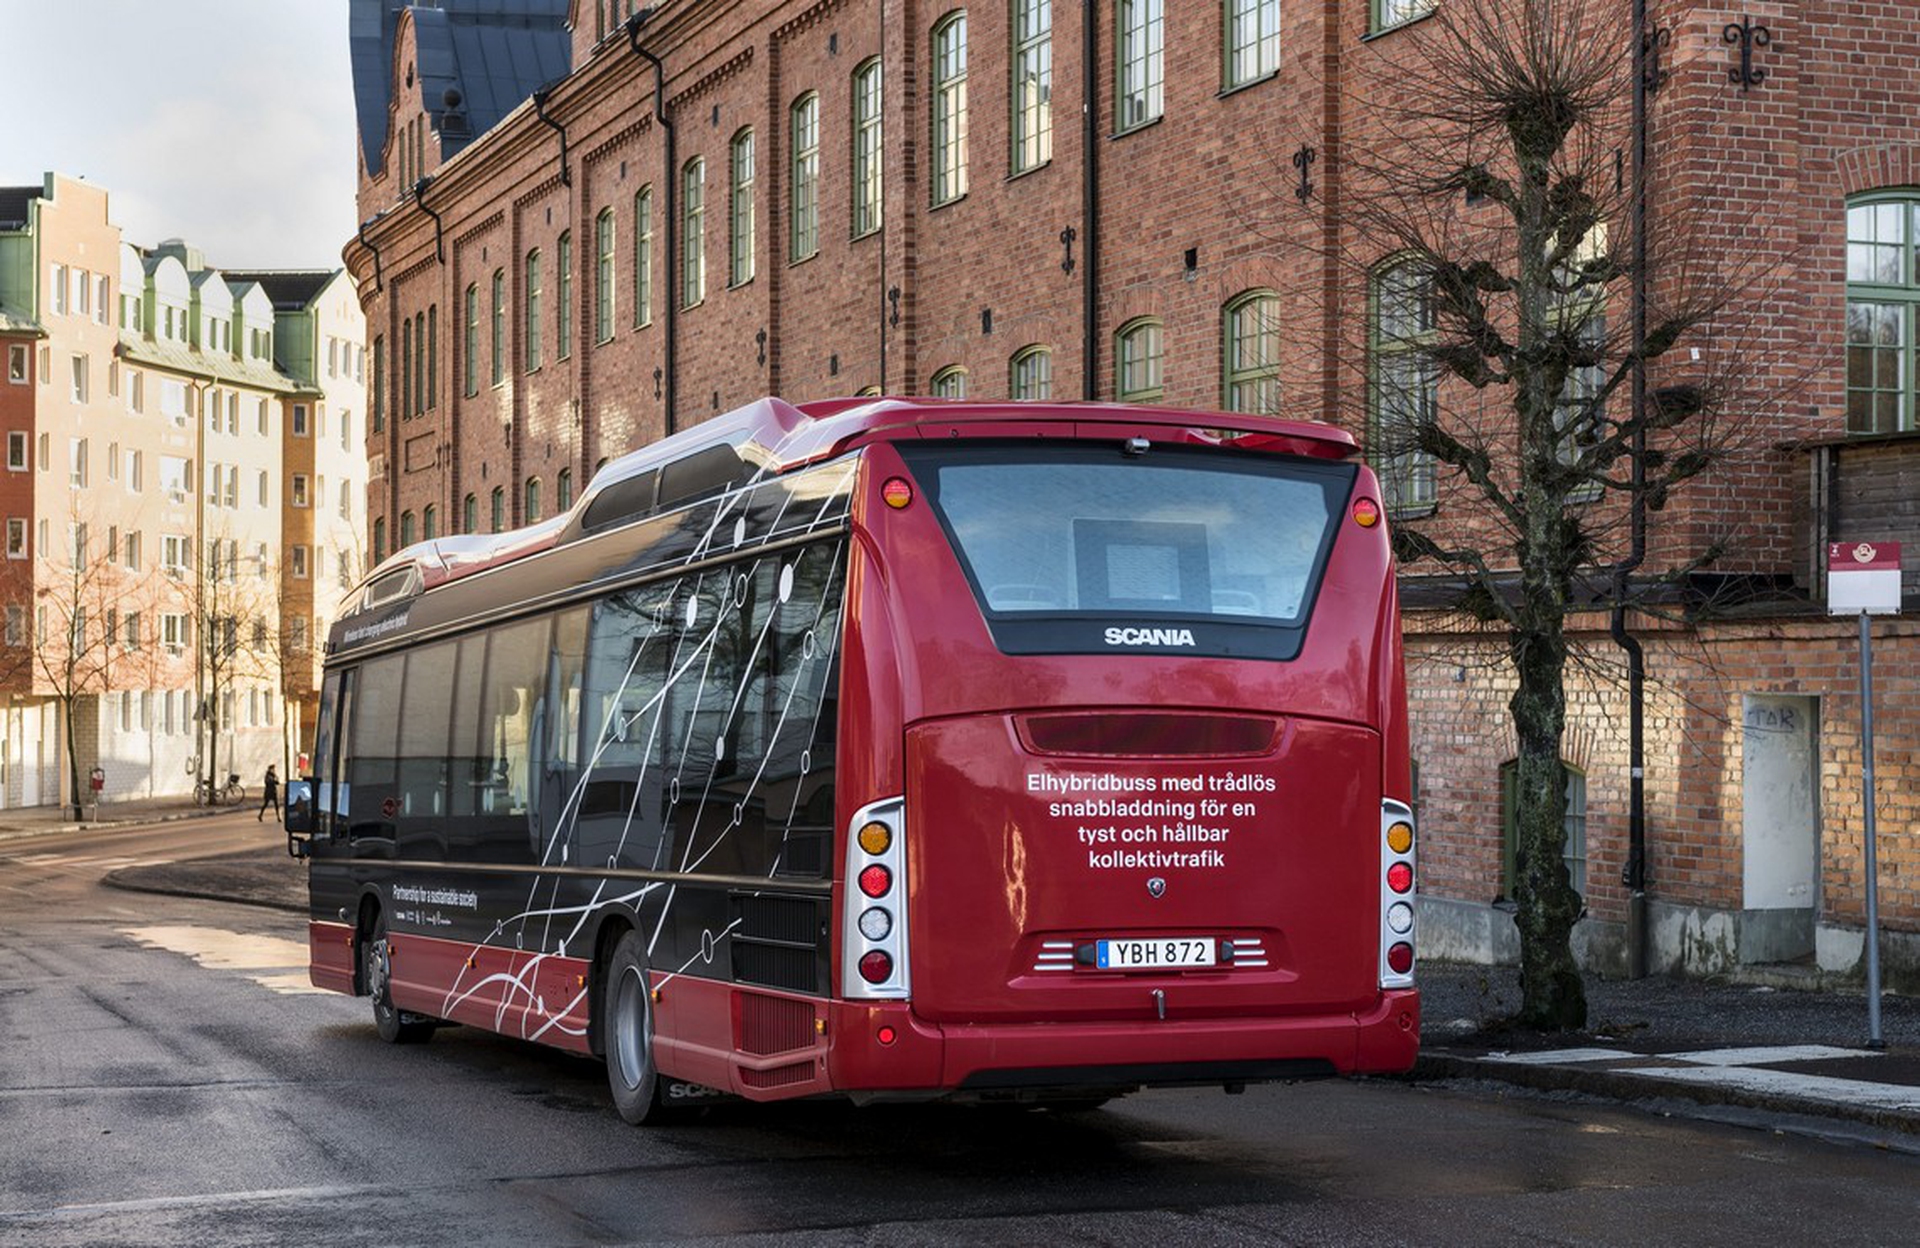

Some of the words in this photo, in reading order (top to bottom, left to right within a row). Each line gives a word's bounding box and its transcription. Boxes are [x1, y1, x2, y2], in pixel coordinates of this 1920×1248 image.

[1104, 627, 1195, 646] SCANIA
[1027, 773, 1157, 792] Elhybridbuss
[1162, 773, 1204, 791] med
[1208, 771, 1276, 792] trådlös
[1049, 800, 1195, 820] snabbladdning
[1200, 799, 1227, 816] för
[1232, 803, 1256, 817] en
[1078, 826, 1117, 843] tyst
[1121, 825, 1158, 843] och
[1162, 822, 1230, 842] hållbar
[1089, 850, 1225, 868] kollektivtrafik
[1116, 942, 1158, 964] YBH
[1165, 941, 1206, 962] 872
